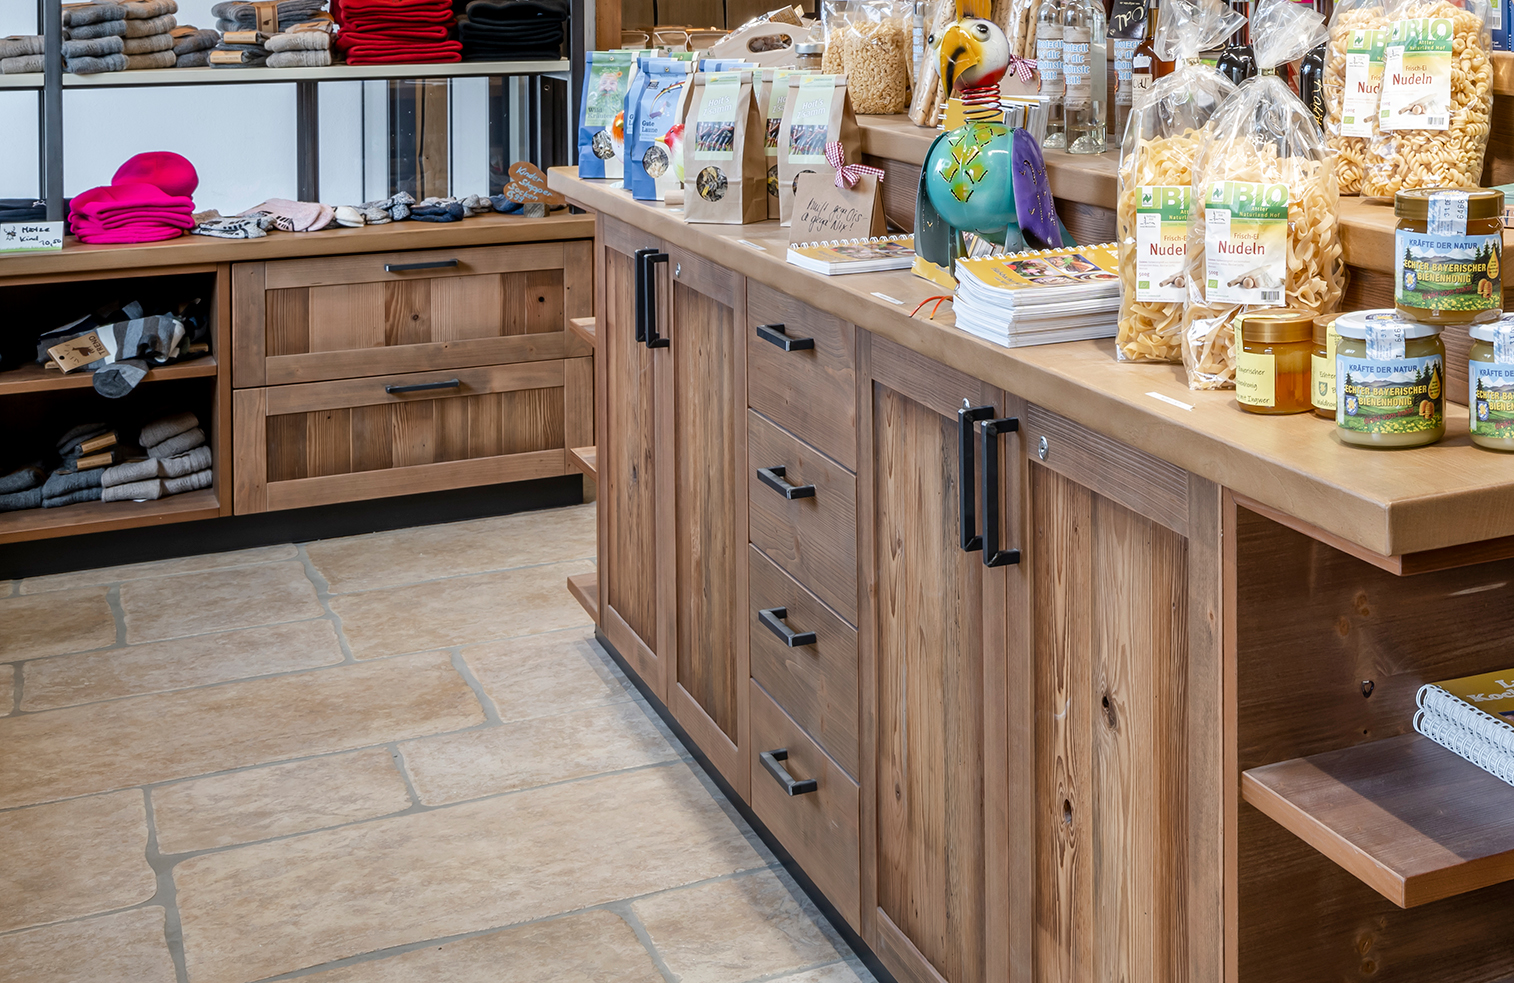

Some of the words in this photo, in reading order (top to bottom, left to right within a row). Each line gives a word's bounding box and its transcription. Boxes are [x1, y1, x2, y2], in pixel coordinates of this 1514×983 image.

[1406, 18, 1453, 41] BIO
[1392, 73, 1432, 85] Nudeln
[642, 126, 658, 134] Laune
[516, 166, 544, 184] Kinder
[508, 182, 539, 202] Socken
[1234, 182, 1289, 208] BIO
[1234, 232, 1260, 240] Frisch-Ei
[1218, 240, 1265, 255] Nudeln
[1409, 238, 1434, 248] KRÄFTE
[1454, 242, 1478, 250] NATUR
[1404, 260, 1430, 271] ECHTER
[1432, 263, 1486, 272] BAYERISCHER
[1416, 272, 1472, 283] BIENENHONIG
[88, 336, 106, 356] TREND
[1348, 364, 1374, 373] KRÄFTE
[1394, 364, 1418, 373] NATUR
[1480, 368, 1502, 377] KRÄFTE
[1344, 384, 1370, 396] ECHTER
[1373, 384, 1428, 396] BAYERISCHER
[1476, 390, 1500, 400] ECHTER
[1248, 396, 1270, 405] Ingwer
[1358, 396, 1412, 407] BIENENHONIG
